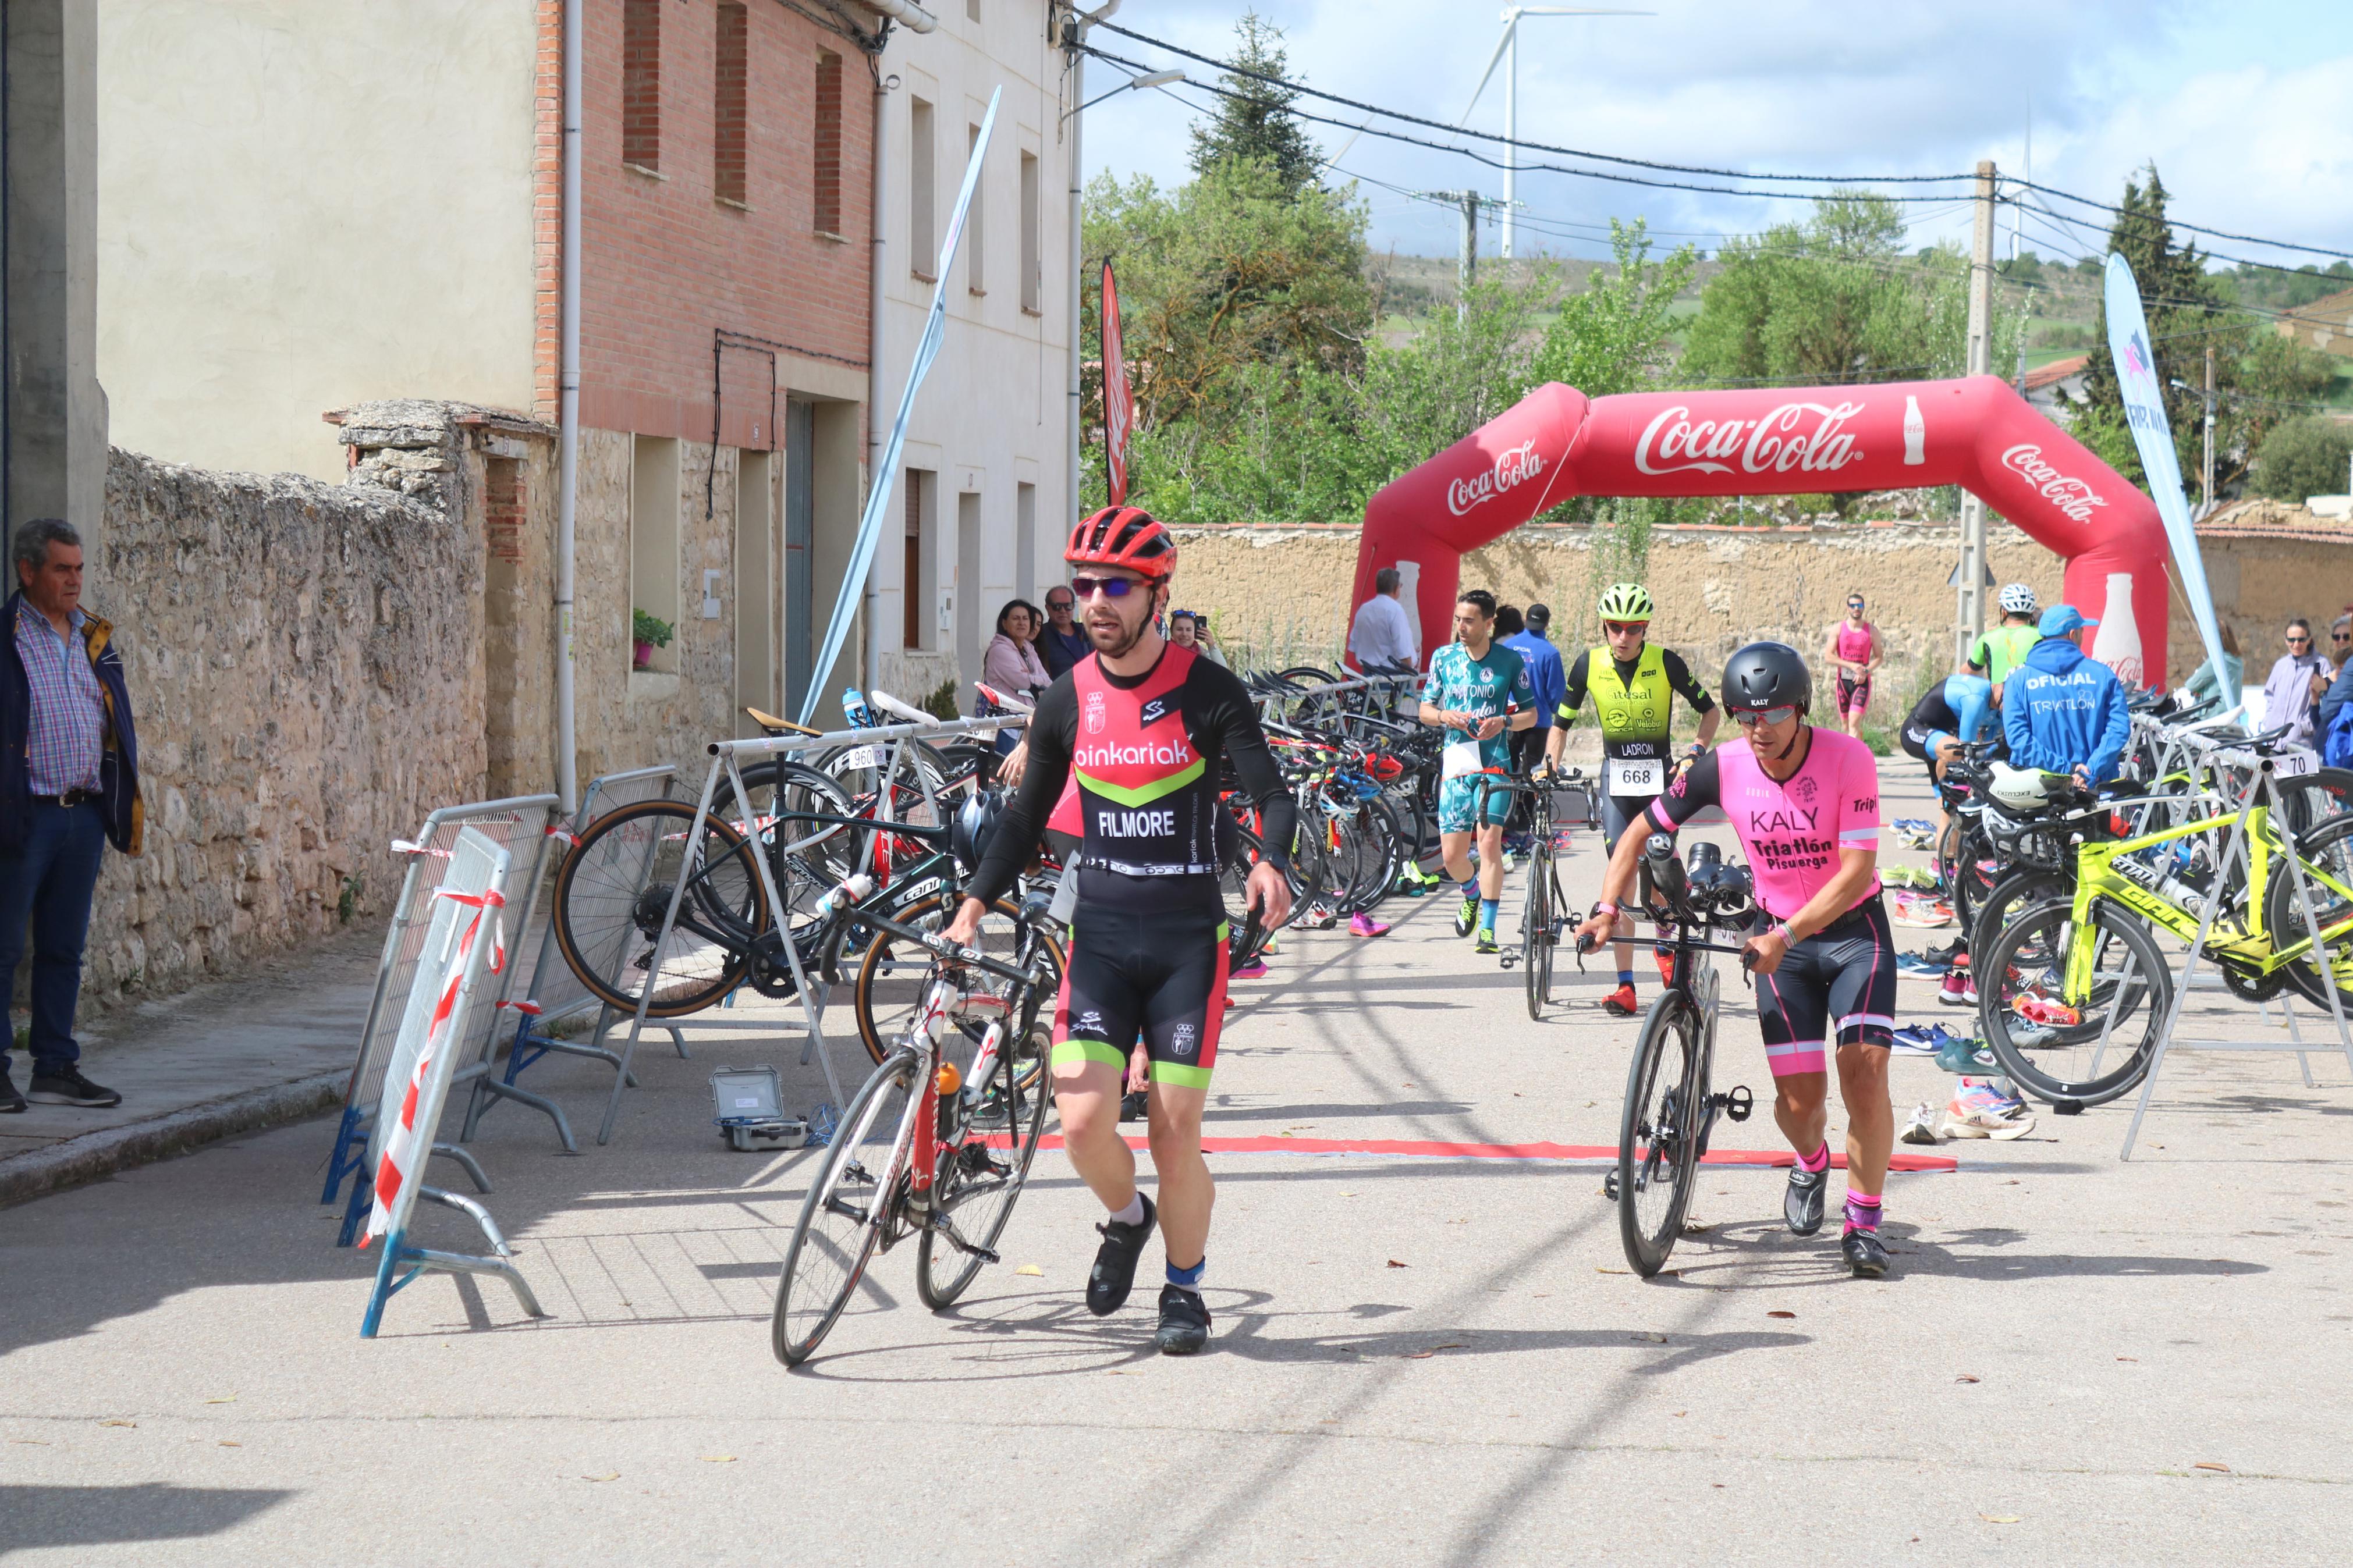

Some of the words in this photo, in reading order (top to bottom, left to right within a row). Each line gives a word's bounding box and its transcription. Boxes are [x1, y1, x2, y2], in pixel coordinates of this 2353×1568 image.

[1634, 402, 1865, 475] Coca-Cola
[1447, 437, 1543, 516] Coca-Cola
[2001, 444, 2109, 522] Coca-Cola
[2026, 673, 2096, 690] OFICIAL
[1751, 698, 1769, 706] KALY
[854, 749, 872, 766] 960
[1621, 744, 1653, 756] LADRON
[2290, 756, 2306, 774] 70
[1623, 770, 1651, 784] 668
[1854, 795, 1877, 813] Tripi
[1098, 811, 1176, 838] FILMORE
[1751, 806, 1818, 833] KALY
[1750, 837, 1832, 857] Triatlón
[1766, 856, 1828, 870] Pisuerga
[2119, 886, 2187, 930] GIAN
[1070, 1023, 1108, 1036] Spiuk
